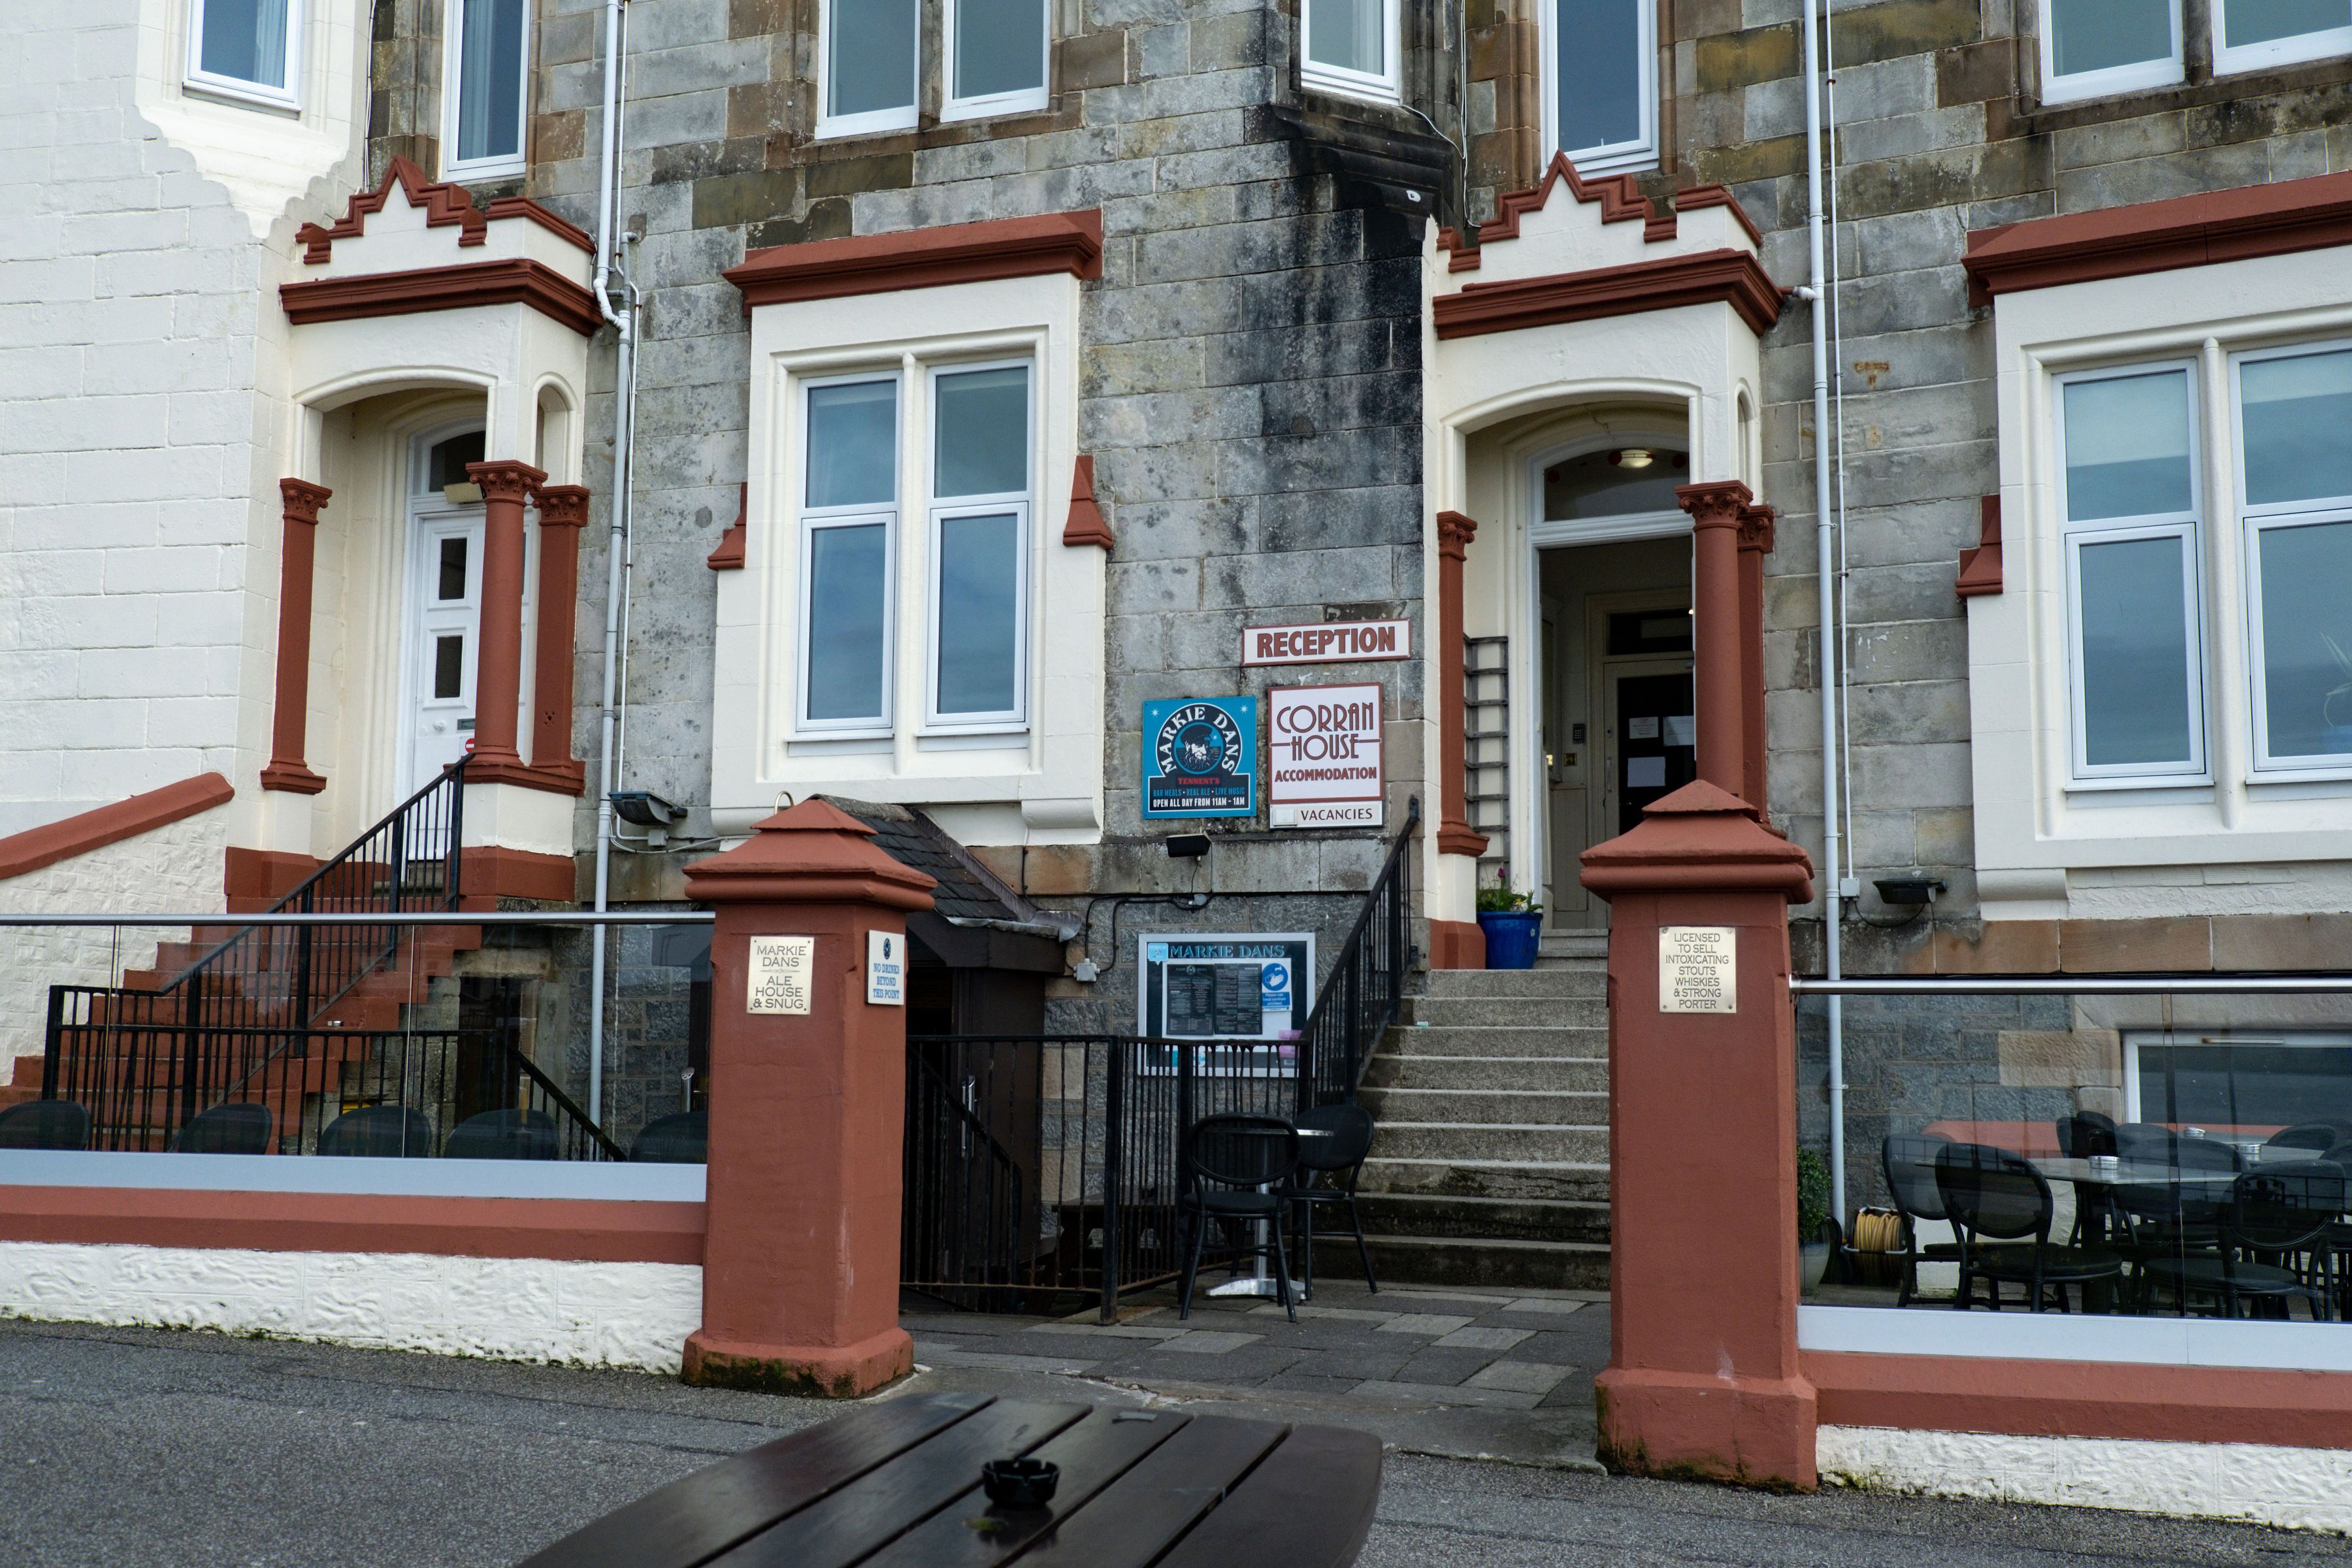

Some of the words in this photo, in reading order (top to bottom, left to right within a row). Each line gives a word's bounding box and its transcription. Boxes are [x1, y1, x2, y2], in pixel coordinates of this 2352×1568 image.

[1257, 626, 1396, 658] RECEPTION
[1276, 702, 1374, 733] CORRAN
[1159, 706, 1205, 774] MARKIE
[1213, 713, 1239, 772] DANS
[1290, 733, 1360, 761] HOUSE
[1275, 766, 1377, 783] ACCOMMODATION
[1153, 799, 1168, 808] OPEN
[1169, 798, 1181, 807] ALL
[1182, 798, 1193, 807] DAY
[1194, 798, 1211, 806] FROM
[1212, 797, 1227, 806] 11AM
[1233, 796, 1245, 805] 1AM
[1300, 808, 1373, 821] VACANCIES
[1674, 933, 1720, 942] LICENSED
[757, 945, 807, 956] MARKIE
[1170, 945, 1233, 958] MARKIE
[1239, 945, 1284, 958] DANS
[1678, 944, 1691, 953] TO
[1693, 944, 1716, 953] SELL
[762, 957, 800, 967] DANS
[1665, 955, 1729, 964] INTOXICATING
[874, 963, 881, 973] NO
[882, 964, 900, 974] DRINKS
[1678, 966, 1716, 975] STOUTS
[766, 975, 792, 986] ALE
[877, 976, 896, 987] BEYOND
[1675, 977, 1720, 987] WHISKIES
[755, 987, 803, 997] HOUSE
[873, 988, 884, 998] THIS
[885, 989, 900, 999] POINT
[1673, 988, 1680, 997] &
[1682, 988, 1722, 998] STRONG
[753, 998, 762, 1008] &
[765, 998, 804, 1009] SNUG
[1679, 1000, 1716, 1009] PORTER
